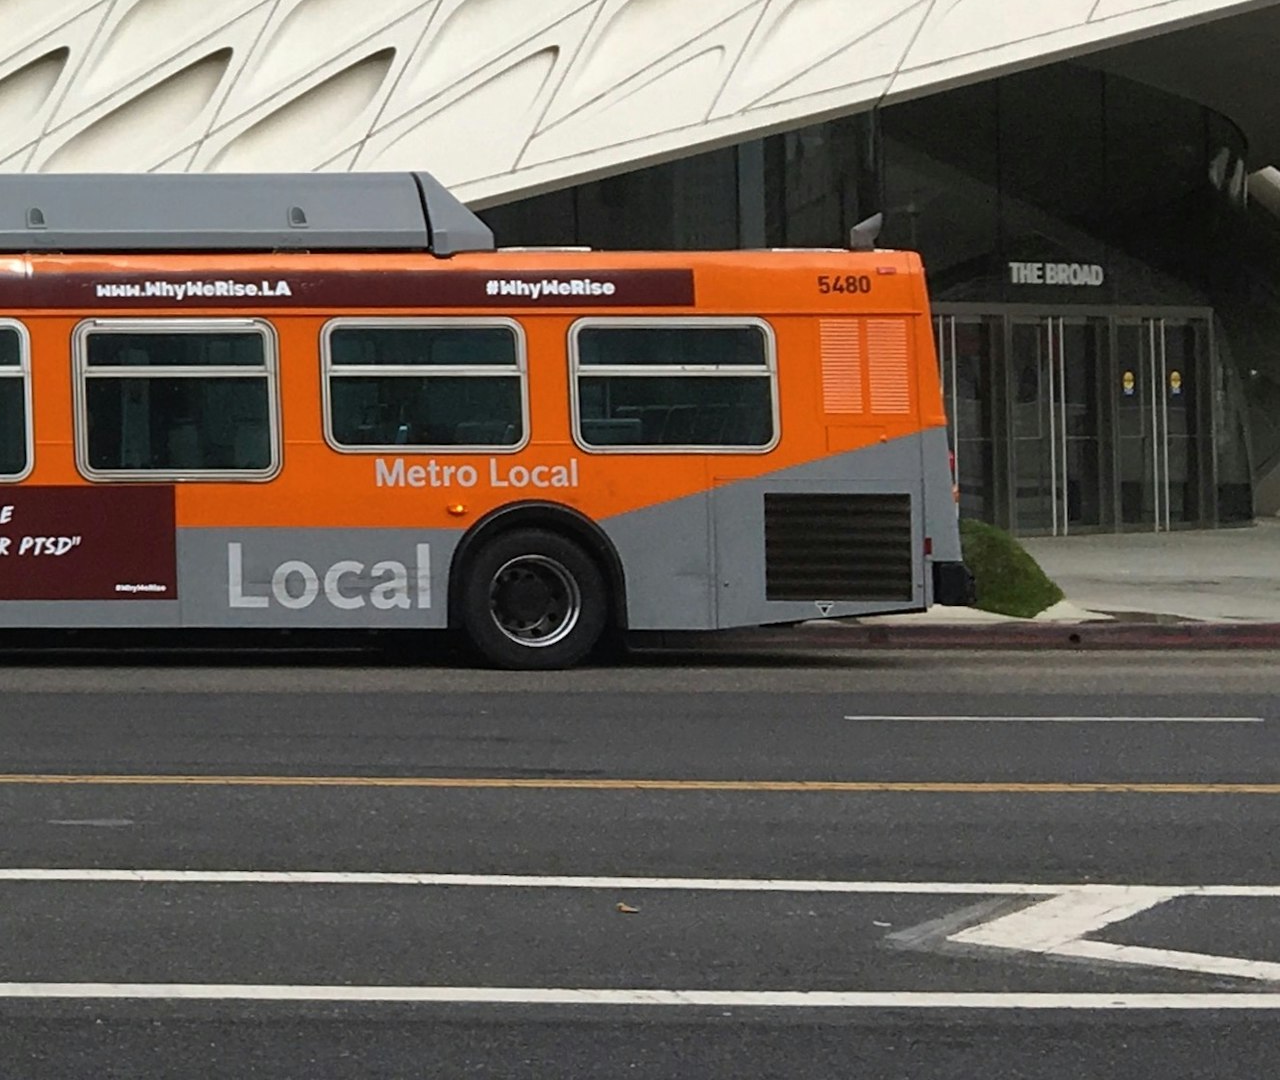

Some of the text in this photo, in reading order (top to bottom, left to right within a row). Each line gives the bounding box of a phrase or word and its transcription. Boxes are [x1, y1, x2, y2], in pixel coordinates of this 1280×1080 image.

[818, 275, 872, 294] 5480
[1009, 262, 1104, 286] THE BROAD
[96, 281, 292, 300] www.WhyWeRise.LA
[486, 280, 616, 298] #WhyWeRise
[375, 458, 579, 487] Metro Local
[227, 542, 432, 610] Local
